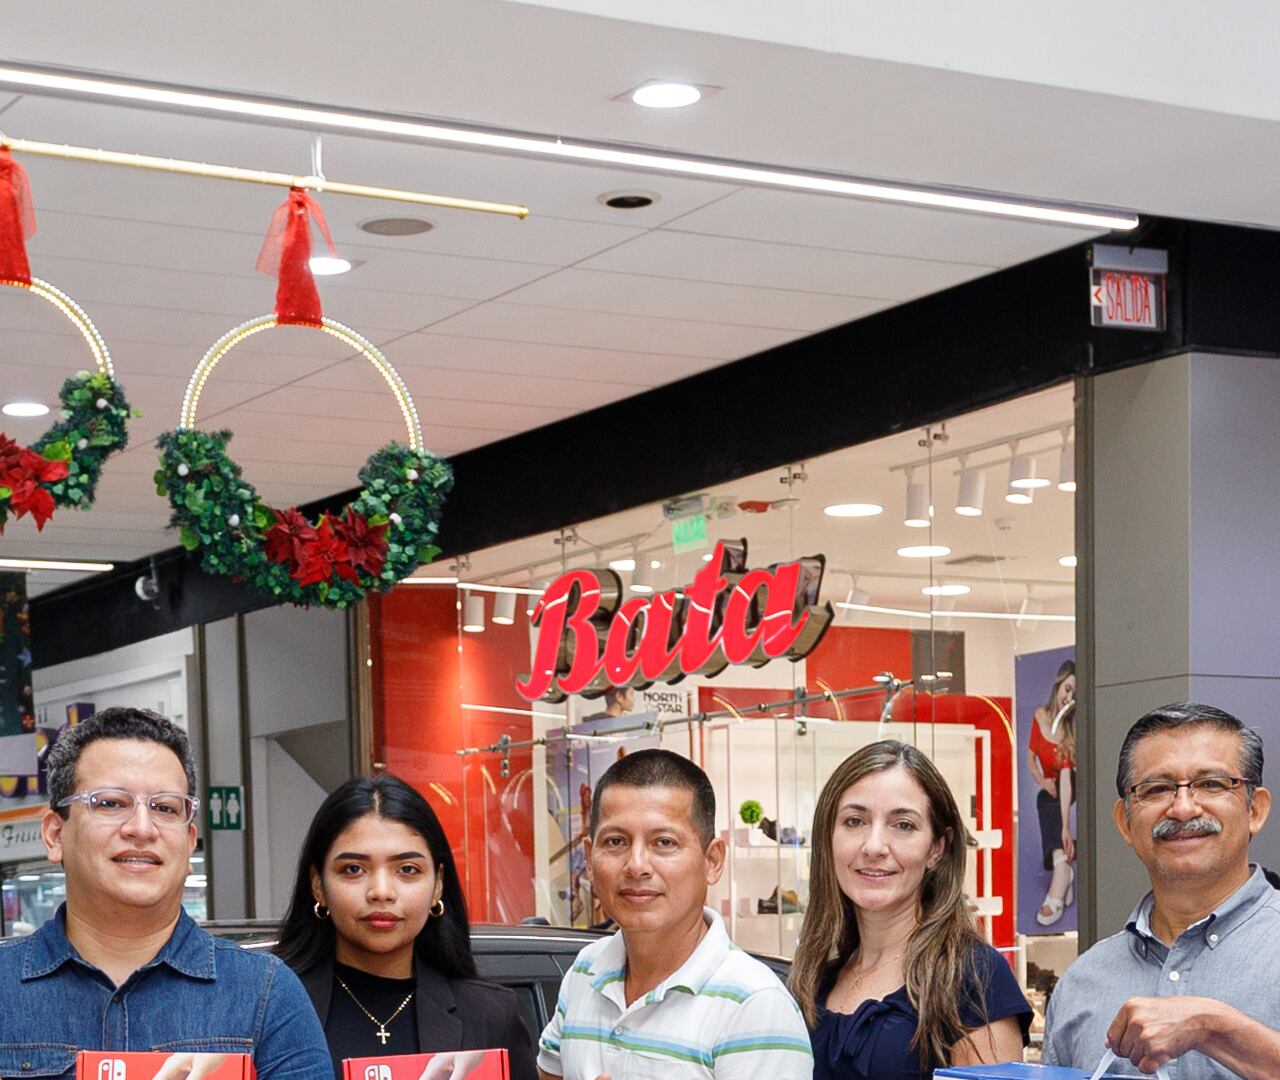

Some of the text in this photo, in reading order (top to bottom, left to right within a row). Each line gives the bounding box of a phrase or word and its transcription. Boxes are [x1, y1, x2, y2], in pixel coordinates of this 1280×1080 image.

[1105, 271, 1152, 324] SALIDA
[515, 542, 812, 700] Bata
[643, 691, 682, 702] NORTH
[656, 703, 683, 713] STAR
